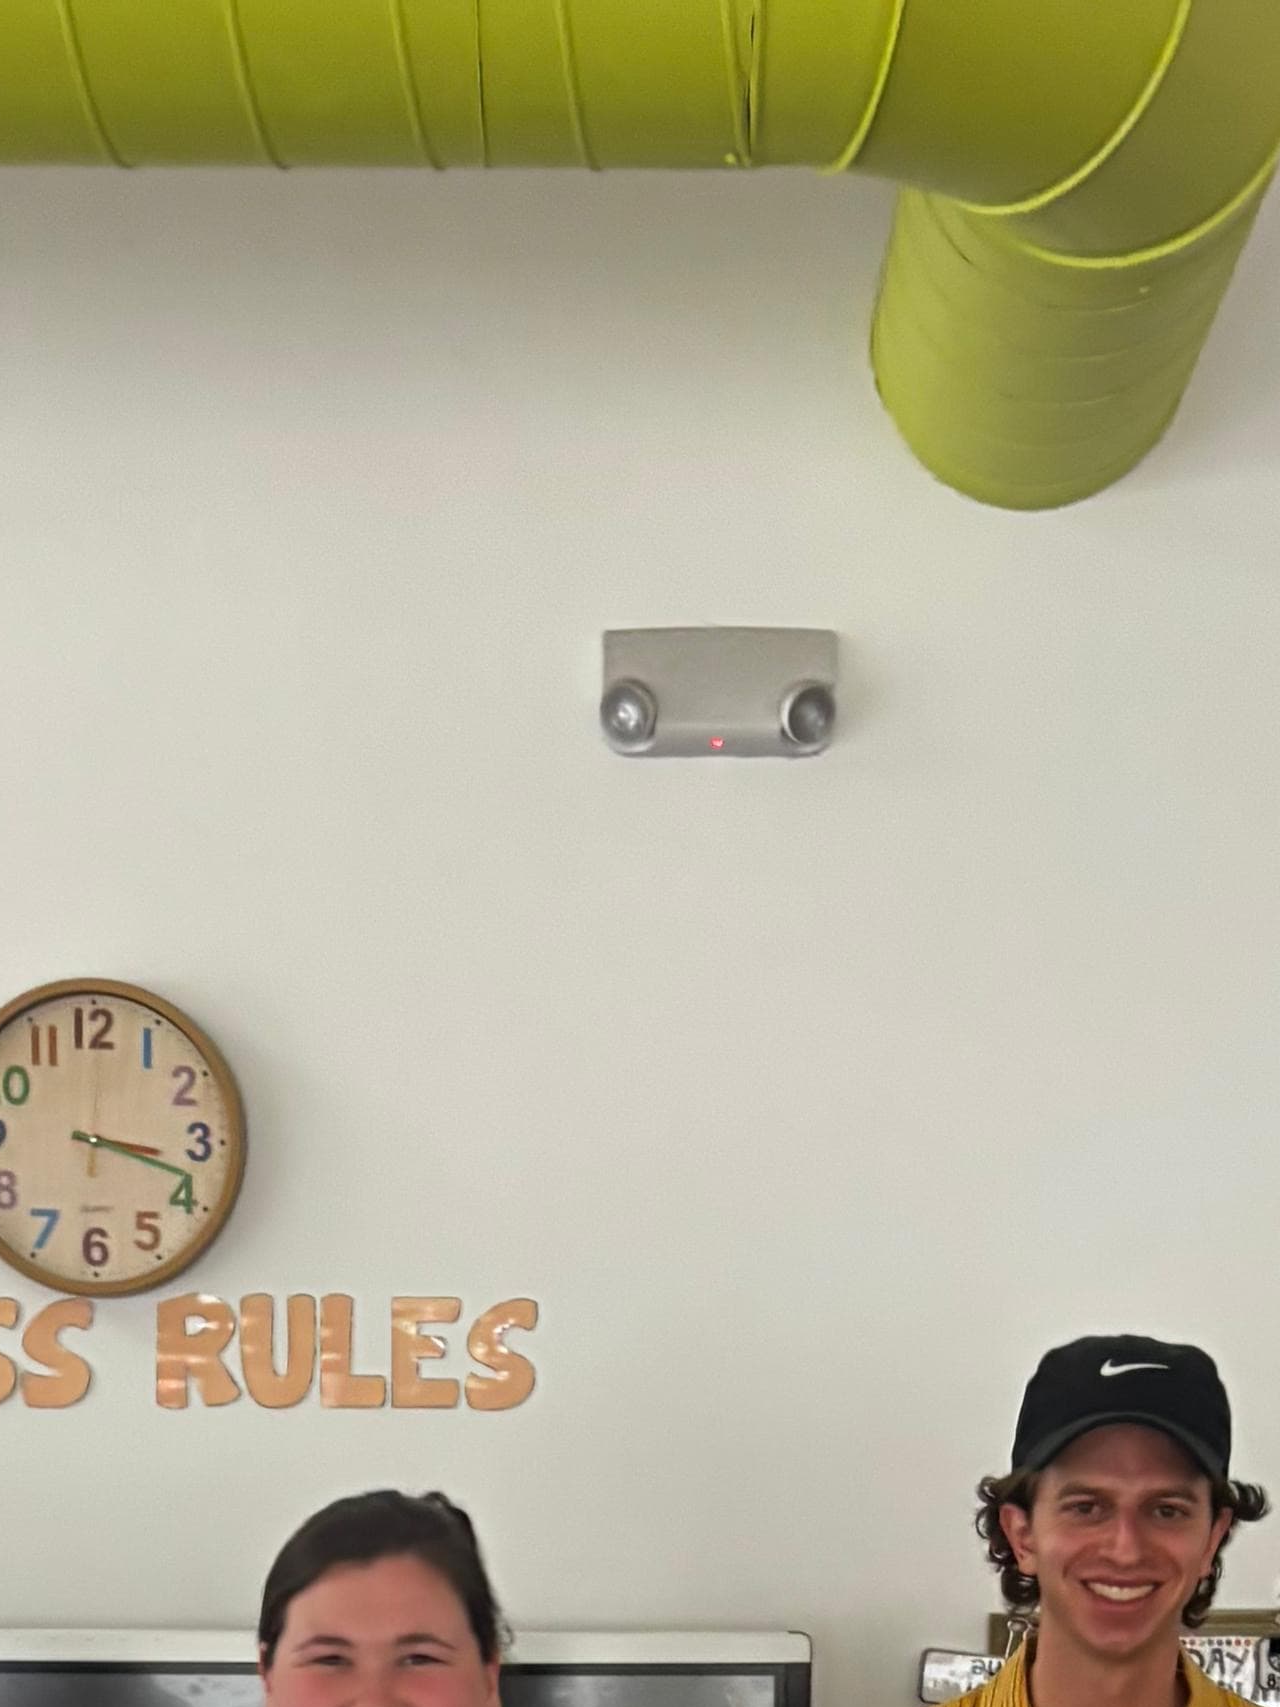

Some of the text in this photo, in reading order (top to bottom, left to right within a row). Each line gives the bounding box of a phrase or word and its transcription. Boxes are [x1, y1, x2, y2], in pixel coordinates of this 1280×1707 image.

[31, 1025, 58, 1066] 11
[74, 1007, 114, 1050] 12
[143, 1028, 152, 1069] 1
[172, 1065, 198, 1106] 2
[185, 1122, 212, 1162] 3
[169, 1173, 197, 1214] 4
[29, 1208, 60, 1249] 7
[82, 1227, 109, 1267] 6
[133, 1211, 161, 1251] 5
[155, 1292, 540, 1412] RULES
